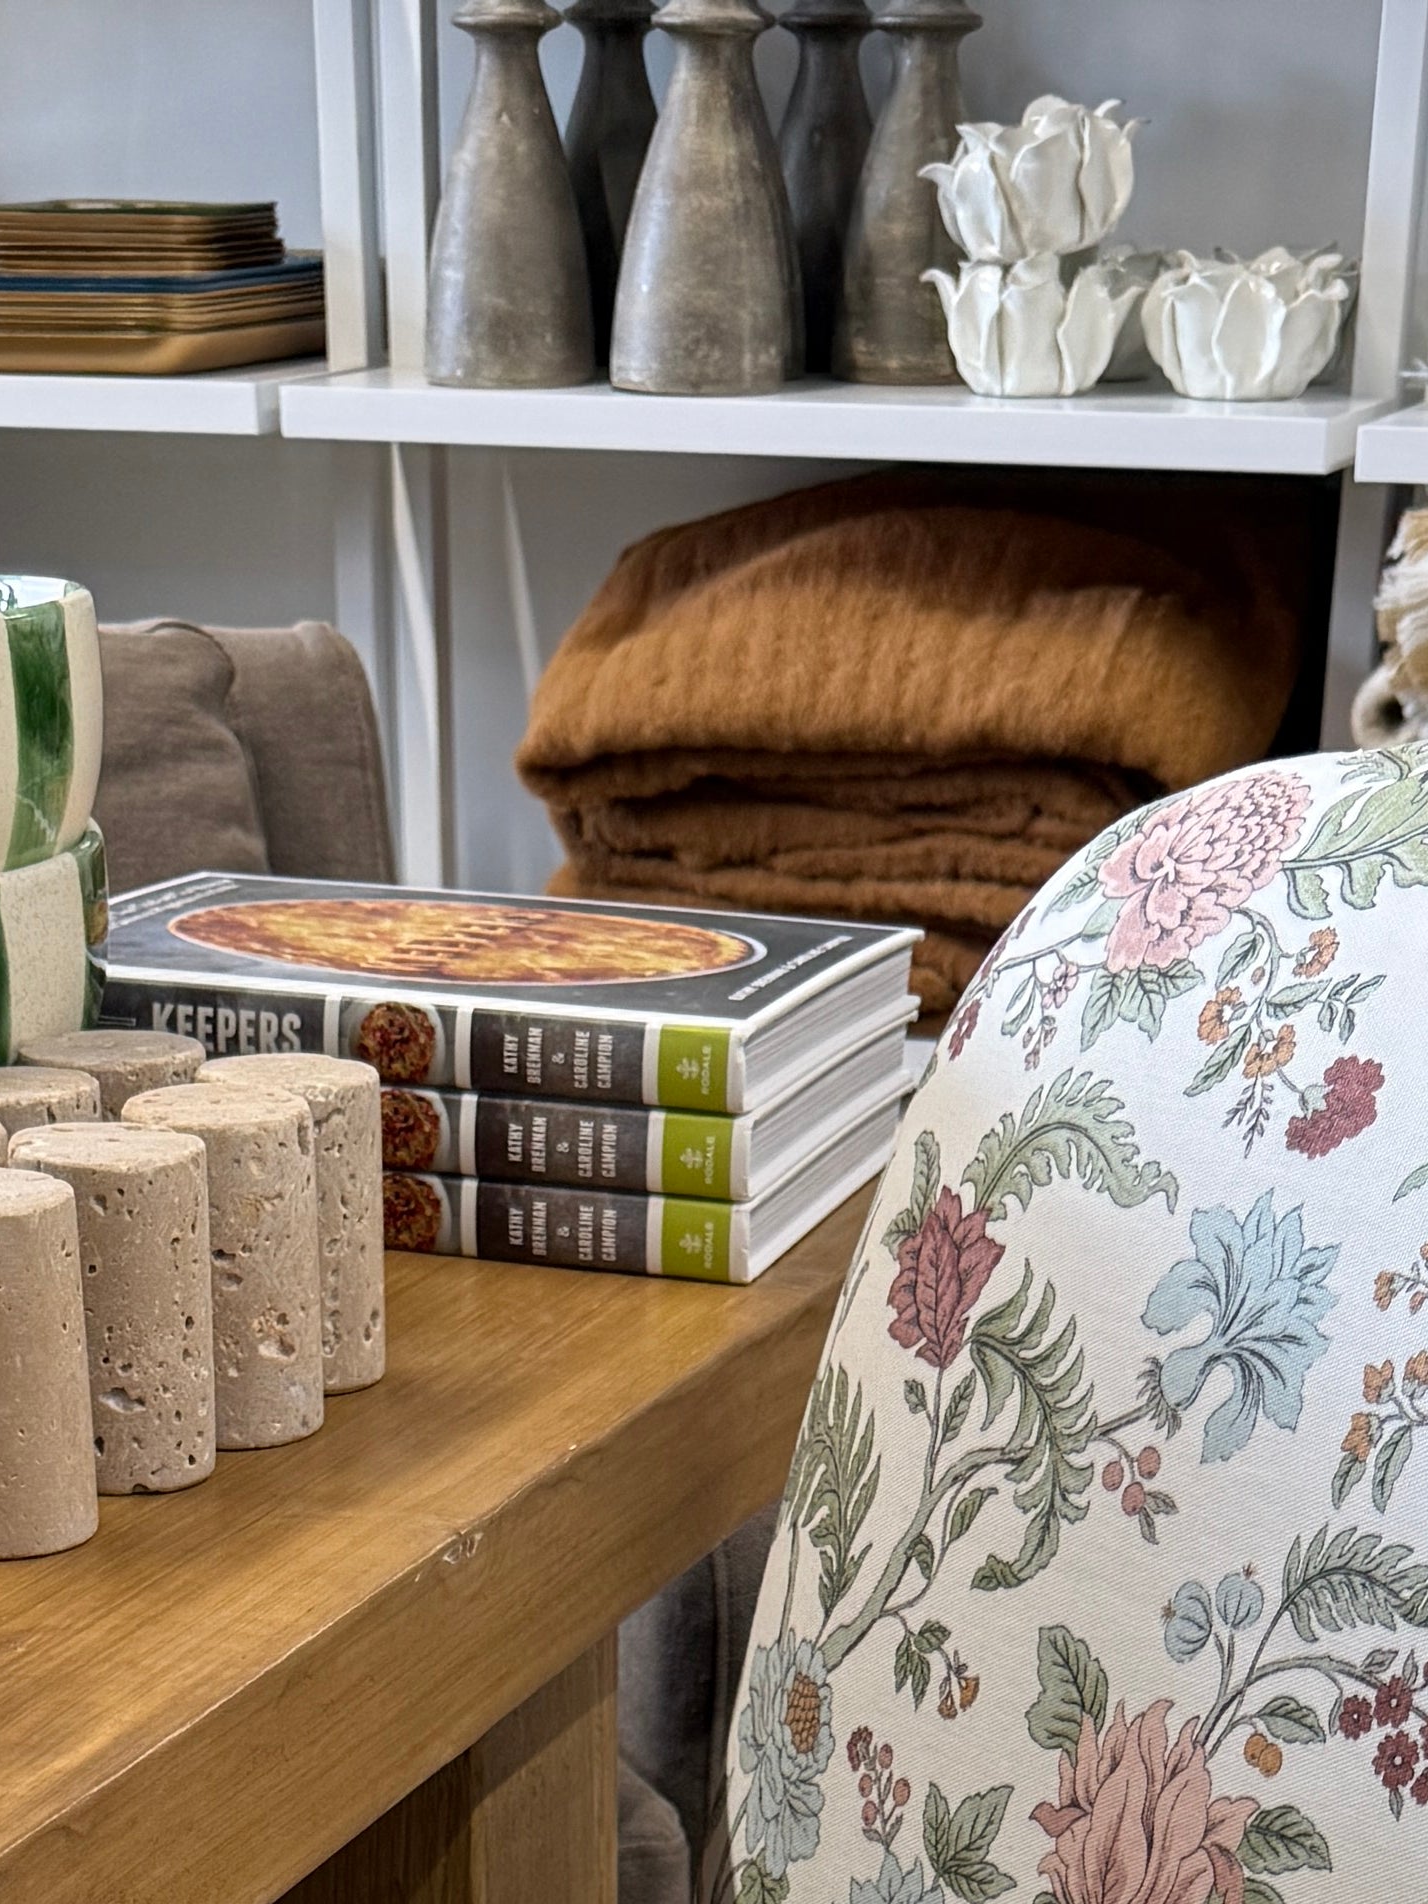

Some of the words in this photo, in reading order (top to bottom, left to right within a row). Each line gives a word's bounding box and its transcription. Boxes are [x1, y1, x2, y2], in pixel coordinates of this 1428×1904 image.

[152, 1002, 302, 1053] KEEPERS
[503, 1033, 519, 1074] KATHY
[526, 1027, 543, 1084] BRENNAN
[552, 1052, 565, 1065] &
[574, 1030, 590, 1089] CAROLINE
[597, 1034, 613, 1089] CAMPION
[508, 1123, 523, 1162] KATHY
[531, 1116, 548, 1172] BRENNAN
[556, 1141, 570, 1153] &
[578, 1120, 594, 1178] CAROLINE
[601, 1124, 617, 1178] CAMPION
[508, 1207, 524, 1246] KATHY
[532, 1201, 547, 1256] BRENNAN
[556, 1226, 570, 1238] &
[578, 1204, 594, 1261] CAROLINE
[601, 1208, 617, 1261] CAMPION
